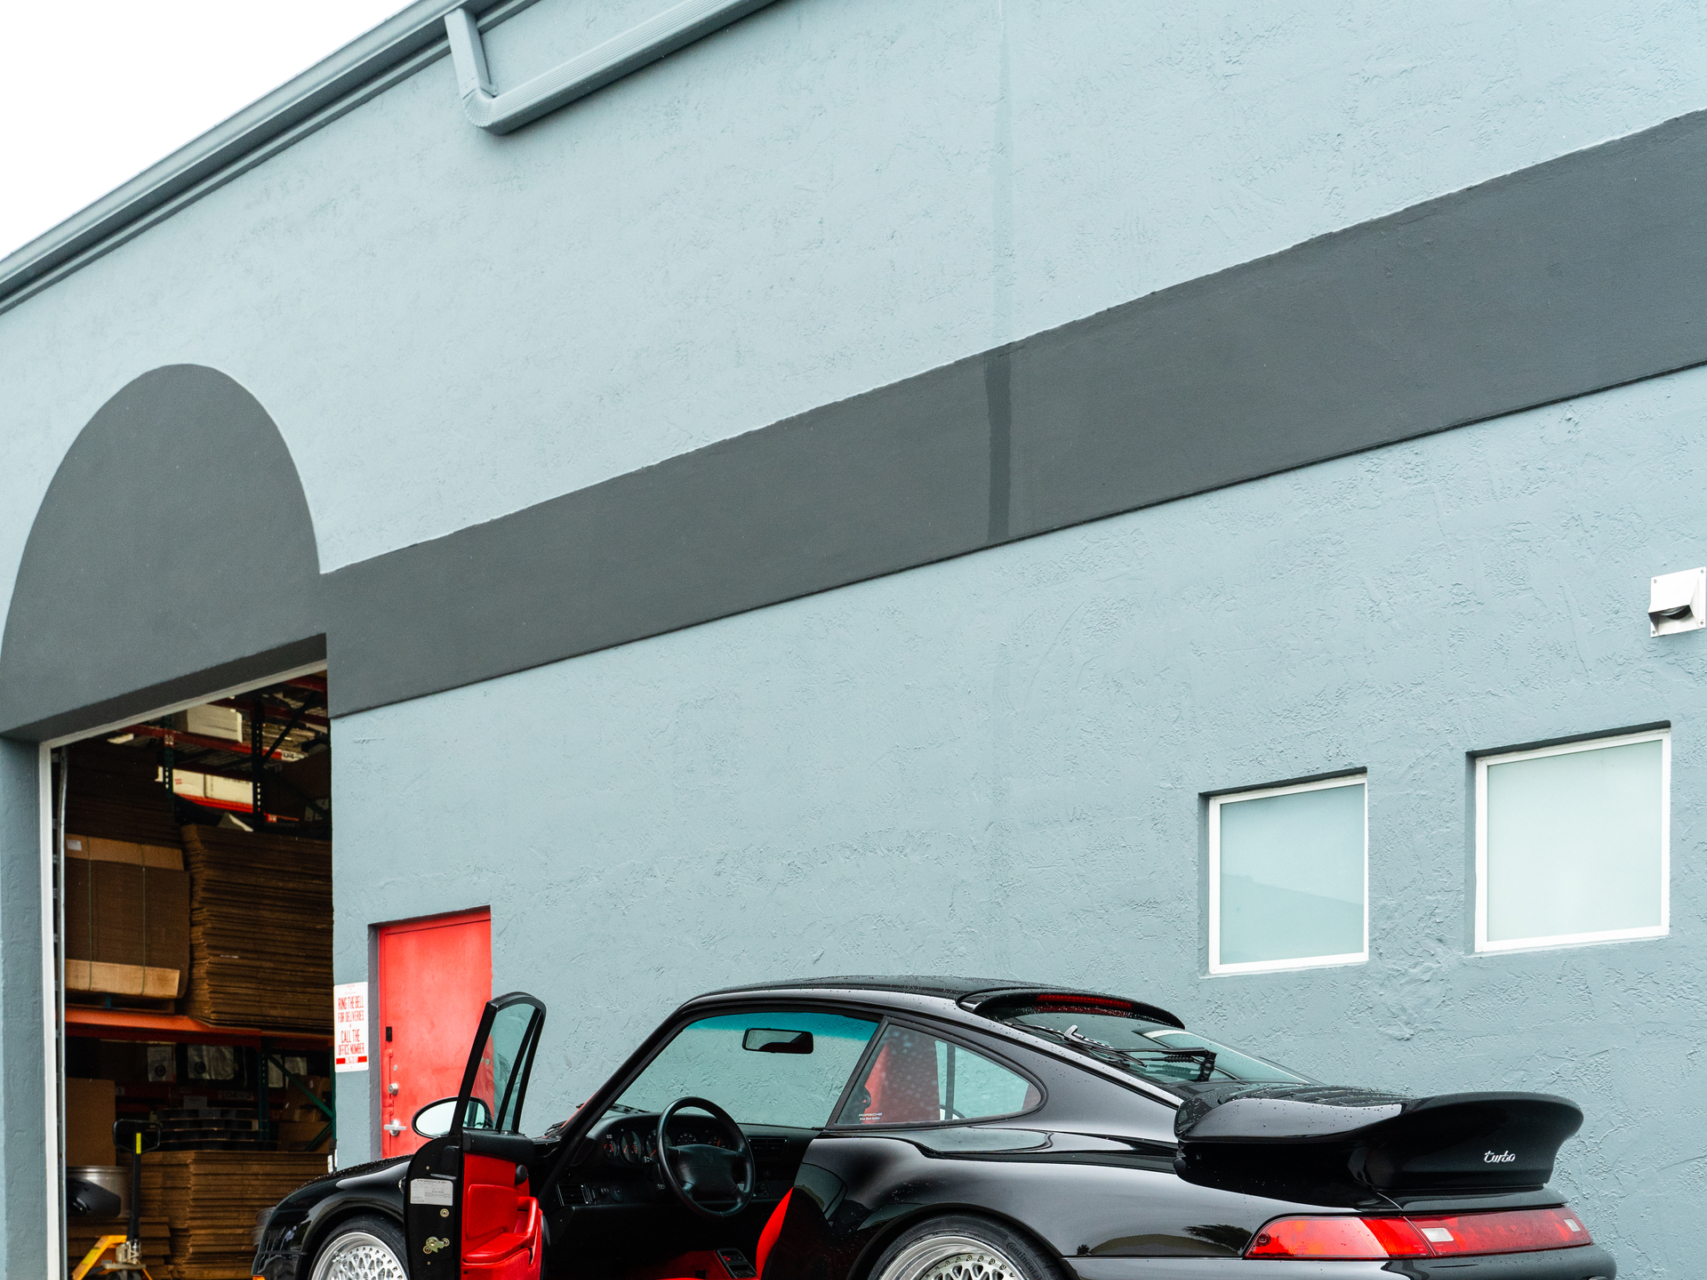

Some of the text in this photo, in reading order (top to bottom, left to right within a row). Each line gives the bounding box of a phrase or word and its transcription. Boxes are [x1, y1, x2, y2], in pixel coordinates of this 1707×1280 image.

[338, 995, 364, 1010] RING THE BELL
[341, 1028, 360, 1043] CALL THE
[338, 1042, 365, 1056] OFFICE NUMBER
[1484, 1150, 1516, 1163] turbo
